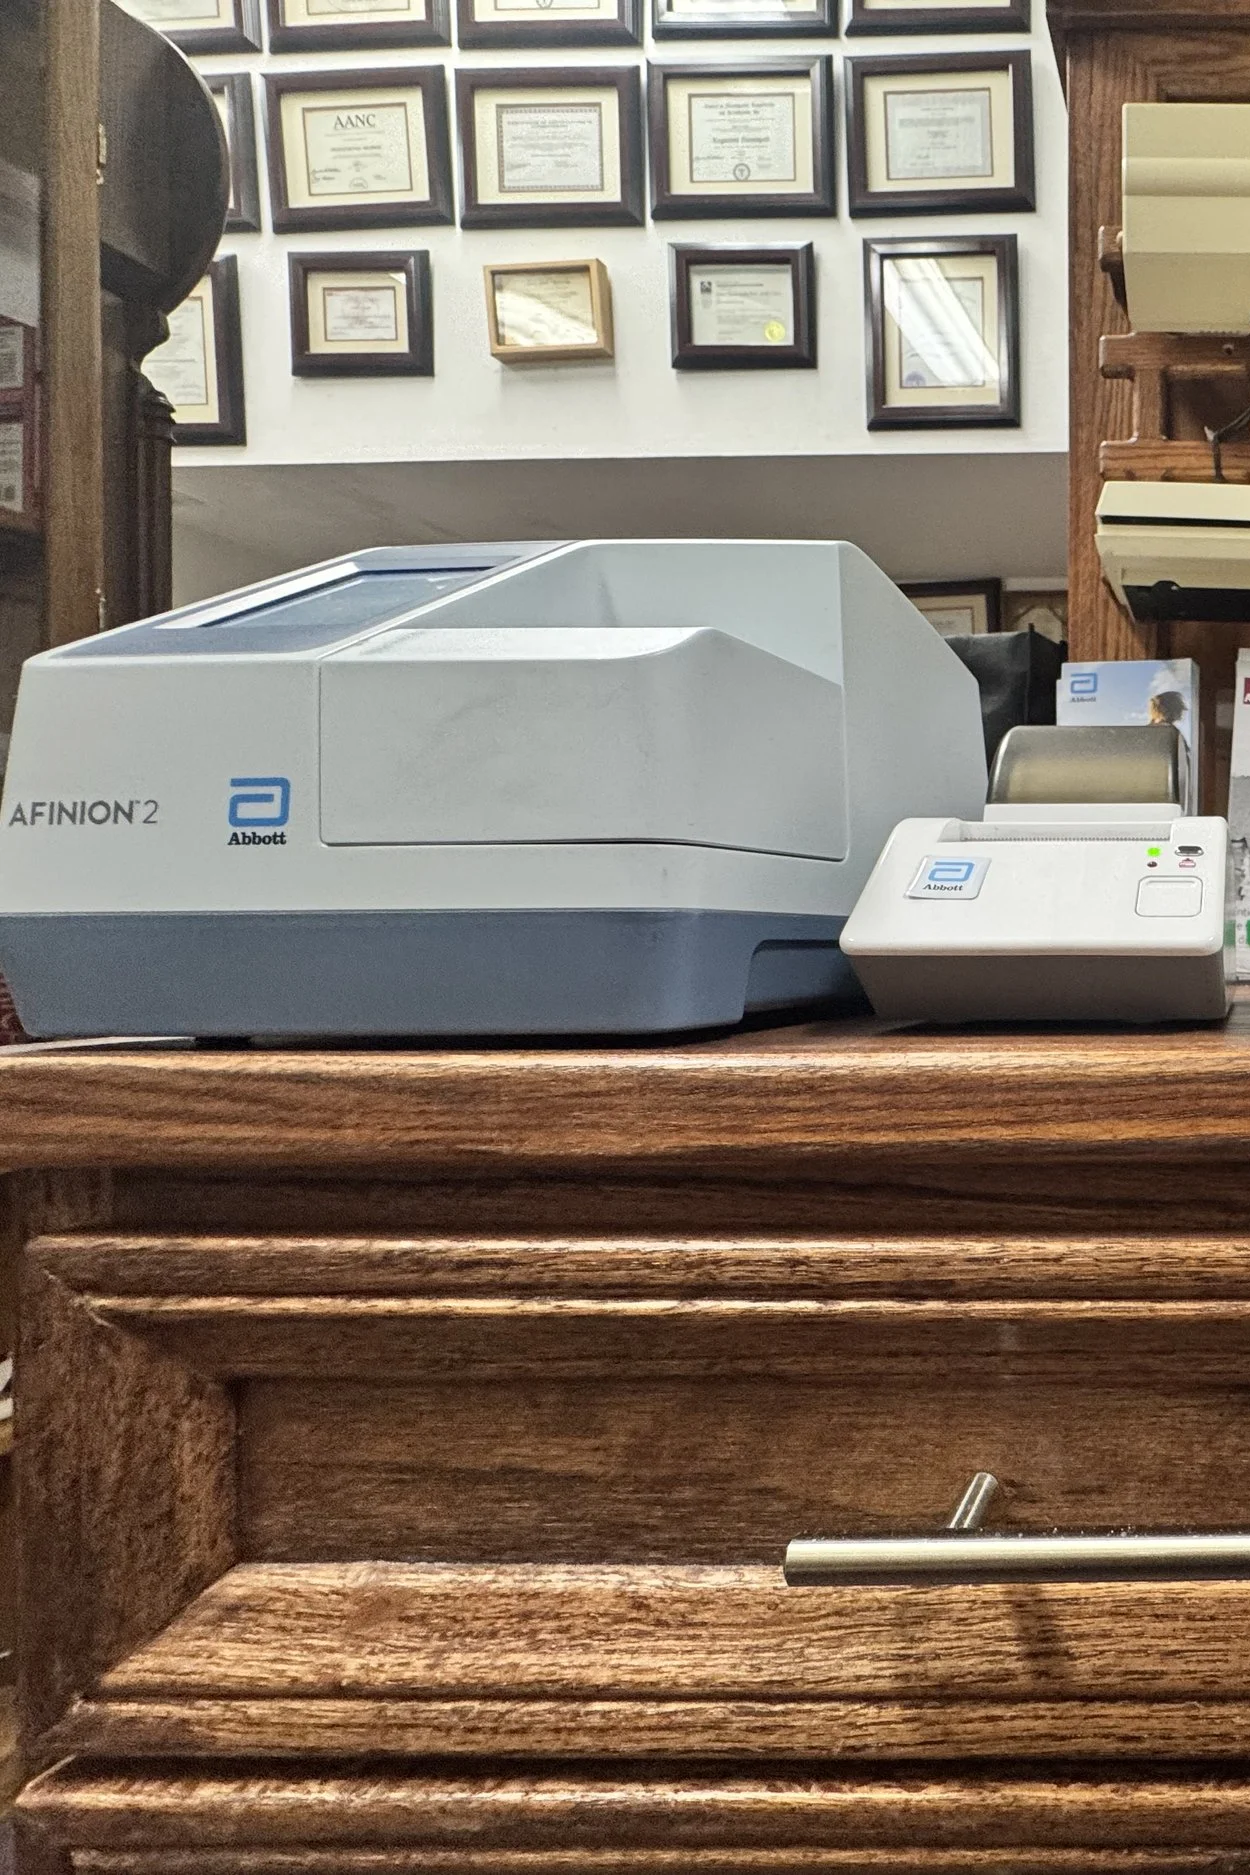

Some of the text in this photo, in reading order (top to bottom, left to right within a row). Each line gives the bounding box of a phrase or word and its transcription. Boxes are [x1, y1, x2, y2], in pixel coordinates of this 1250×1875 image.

[333, 113, 376, 131] AANC
[228, 832, 286, 845] Abbott
[922, 883, 963, 891] Abbott
